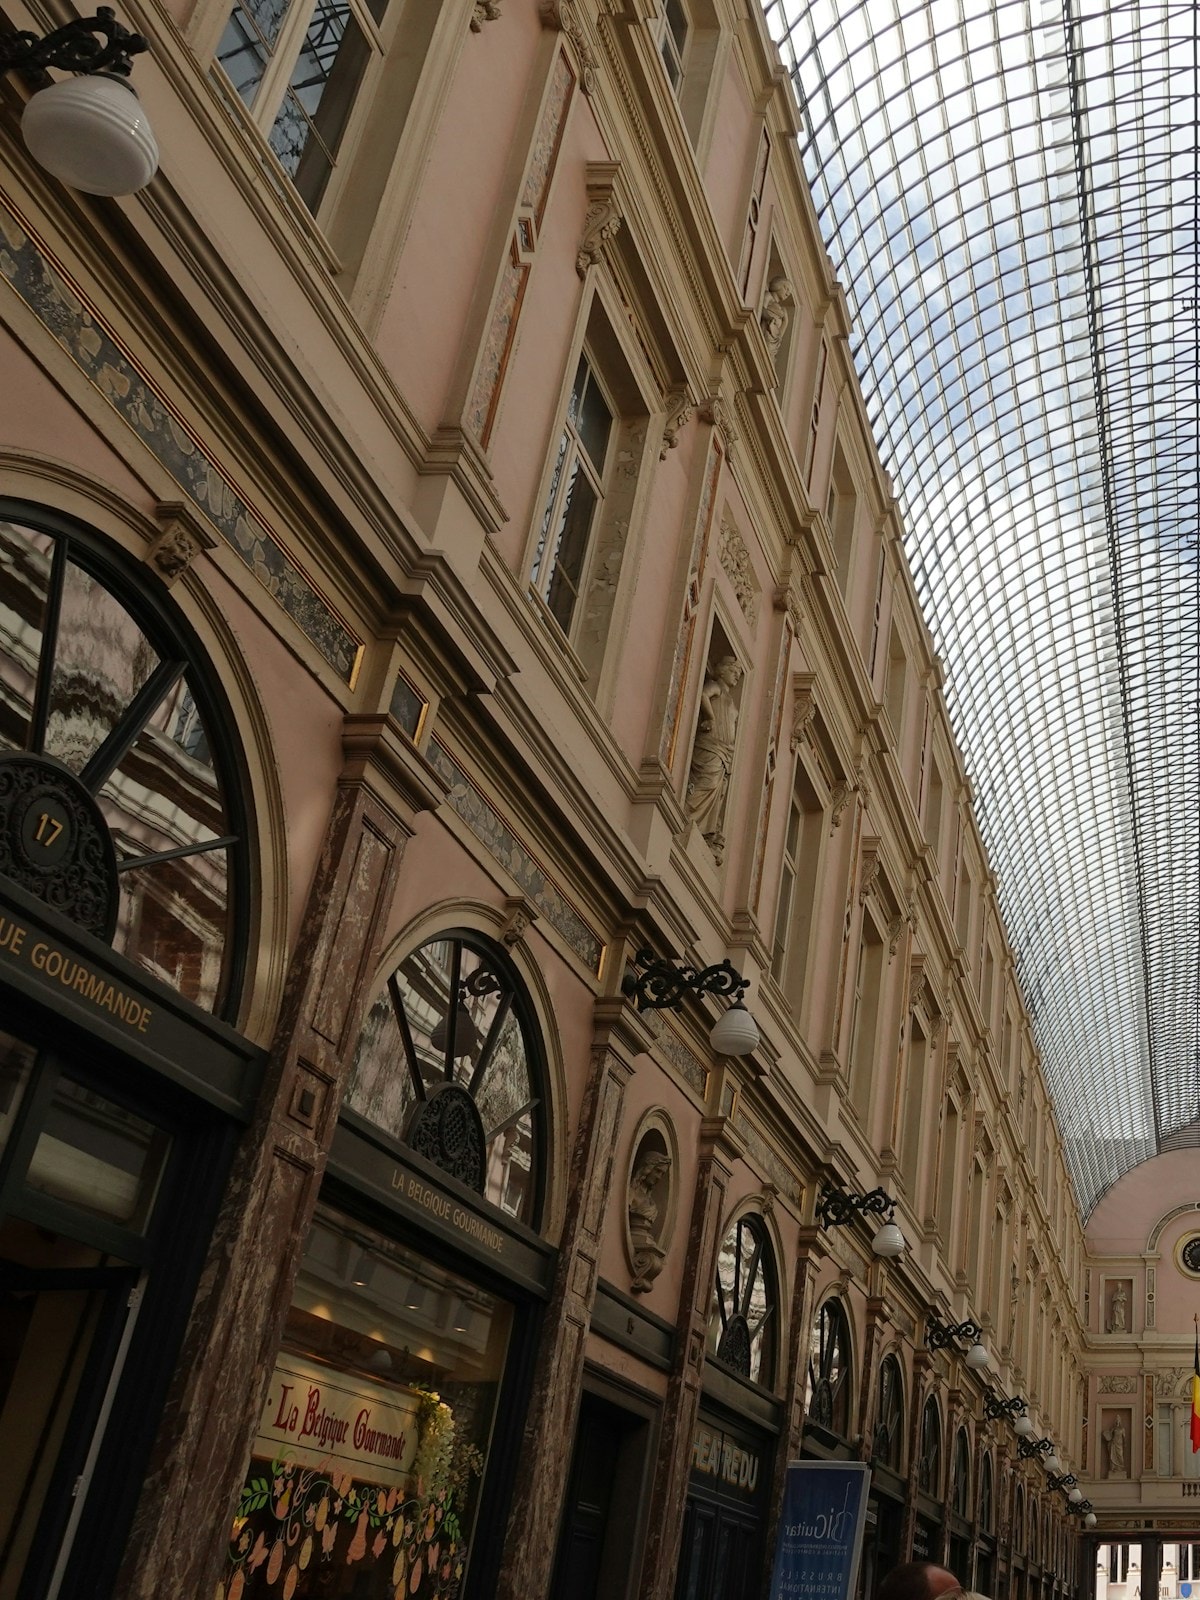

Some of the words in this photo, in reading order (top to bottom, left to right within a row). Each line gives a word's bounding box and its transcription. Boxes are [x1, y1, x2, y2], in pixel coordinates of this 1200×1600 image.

[34, 813, 64, 847] 17
[31, 942, 152, 1033] GOURMANDE
[391, 1169, 405, 1193] LA
[407, 1179, 451, 1220] BELGIQUE
[452, 1208, 504, 1253] GOURMANDE
[272, 1384, 299, 1433] La
[297, 1385, 350, 1450] Belgique
[353, 1408, 406, 1461] Gourmande
[739, 1449, 759, 1493] DU
